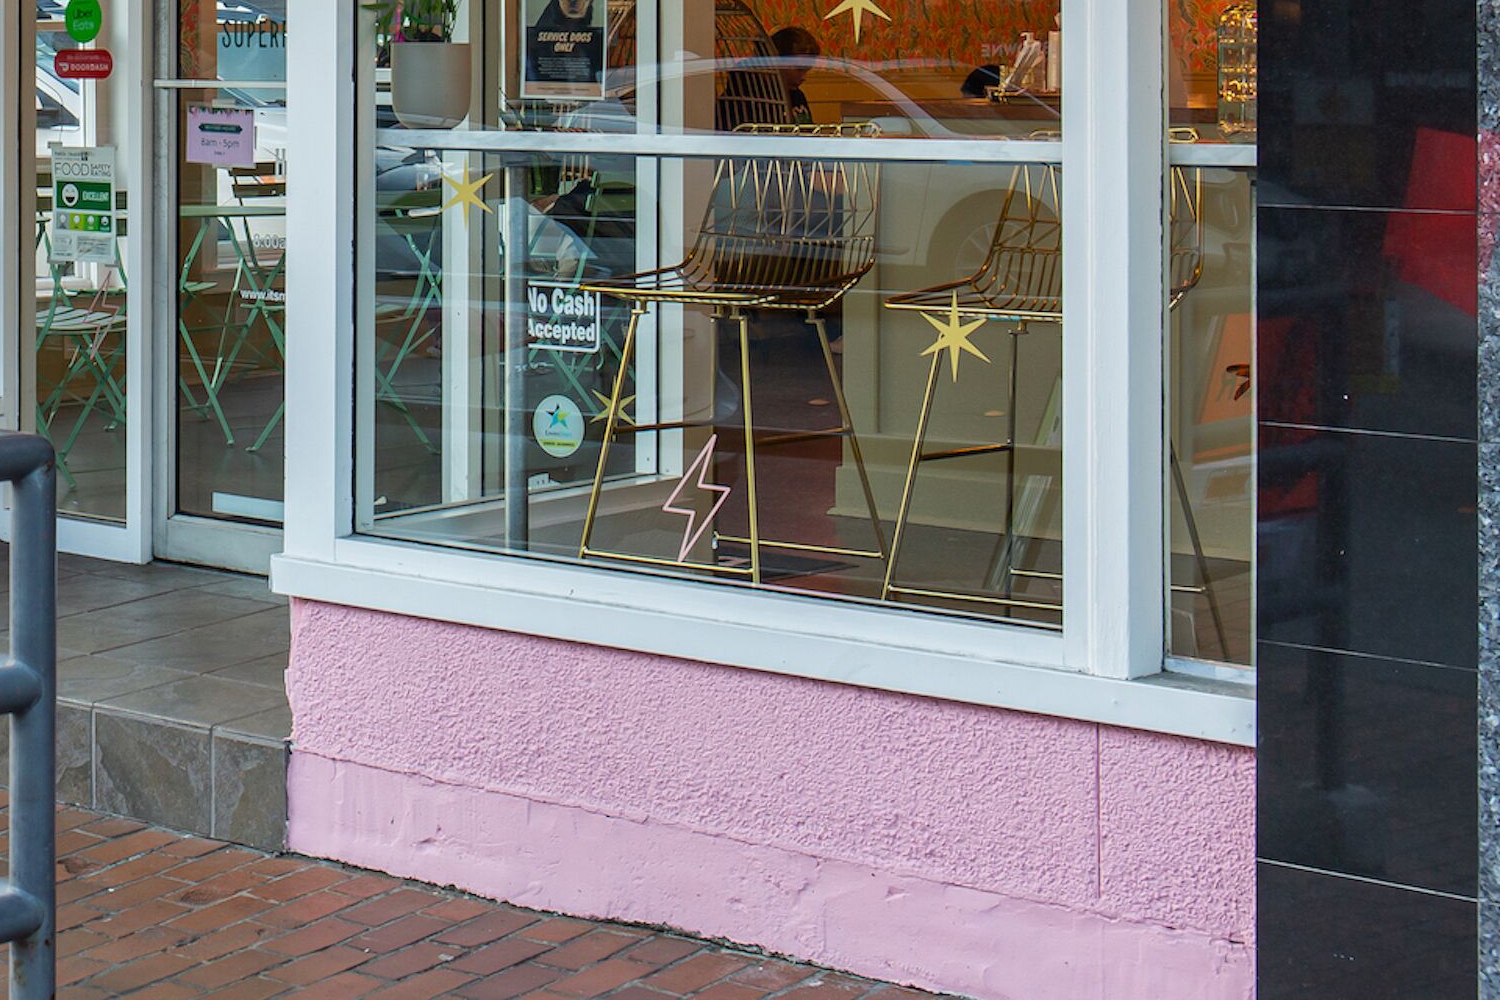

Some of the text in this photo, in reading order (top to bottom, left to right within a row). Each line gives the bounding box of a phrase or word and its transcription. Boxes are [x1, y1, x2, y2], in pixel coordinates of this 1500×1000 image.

[74, 8, 93, 19] Uber
[72, 20, 95, 31] Eats
[537, 31, 593, 43] SERVICE DOGS
[553, 42, 576, 53] ONLY
[69, 63, 109, 72] DOORDASH
[222, 138, 240, 149] 5pm
[54, 162, 90, 176] FOOD
[90, 169, 112, 177] RATING
[82, 190, 110, 202] EXCELLENT
[551, 287, 595, 317] Cash
